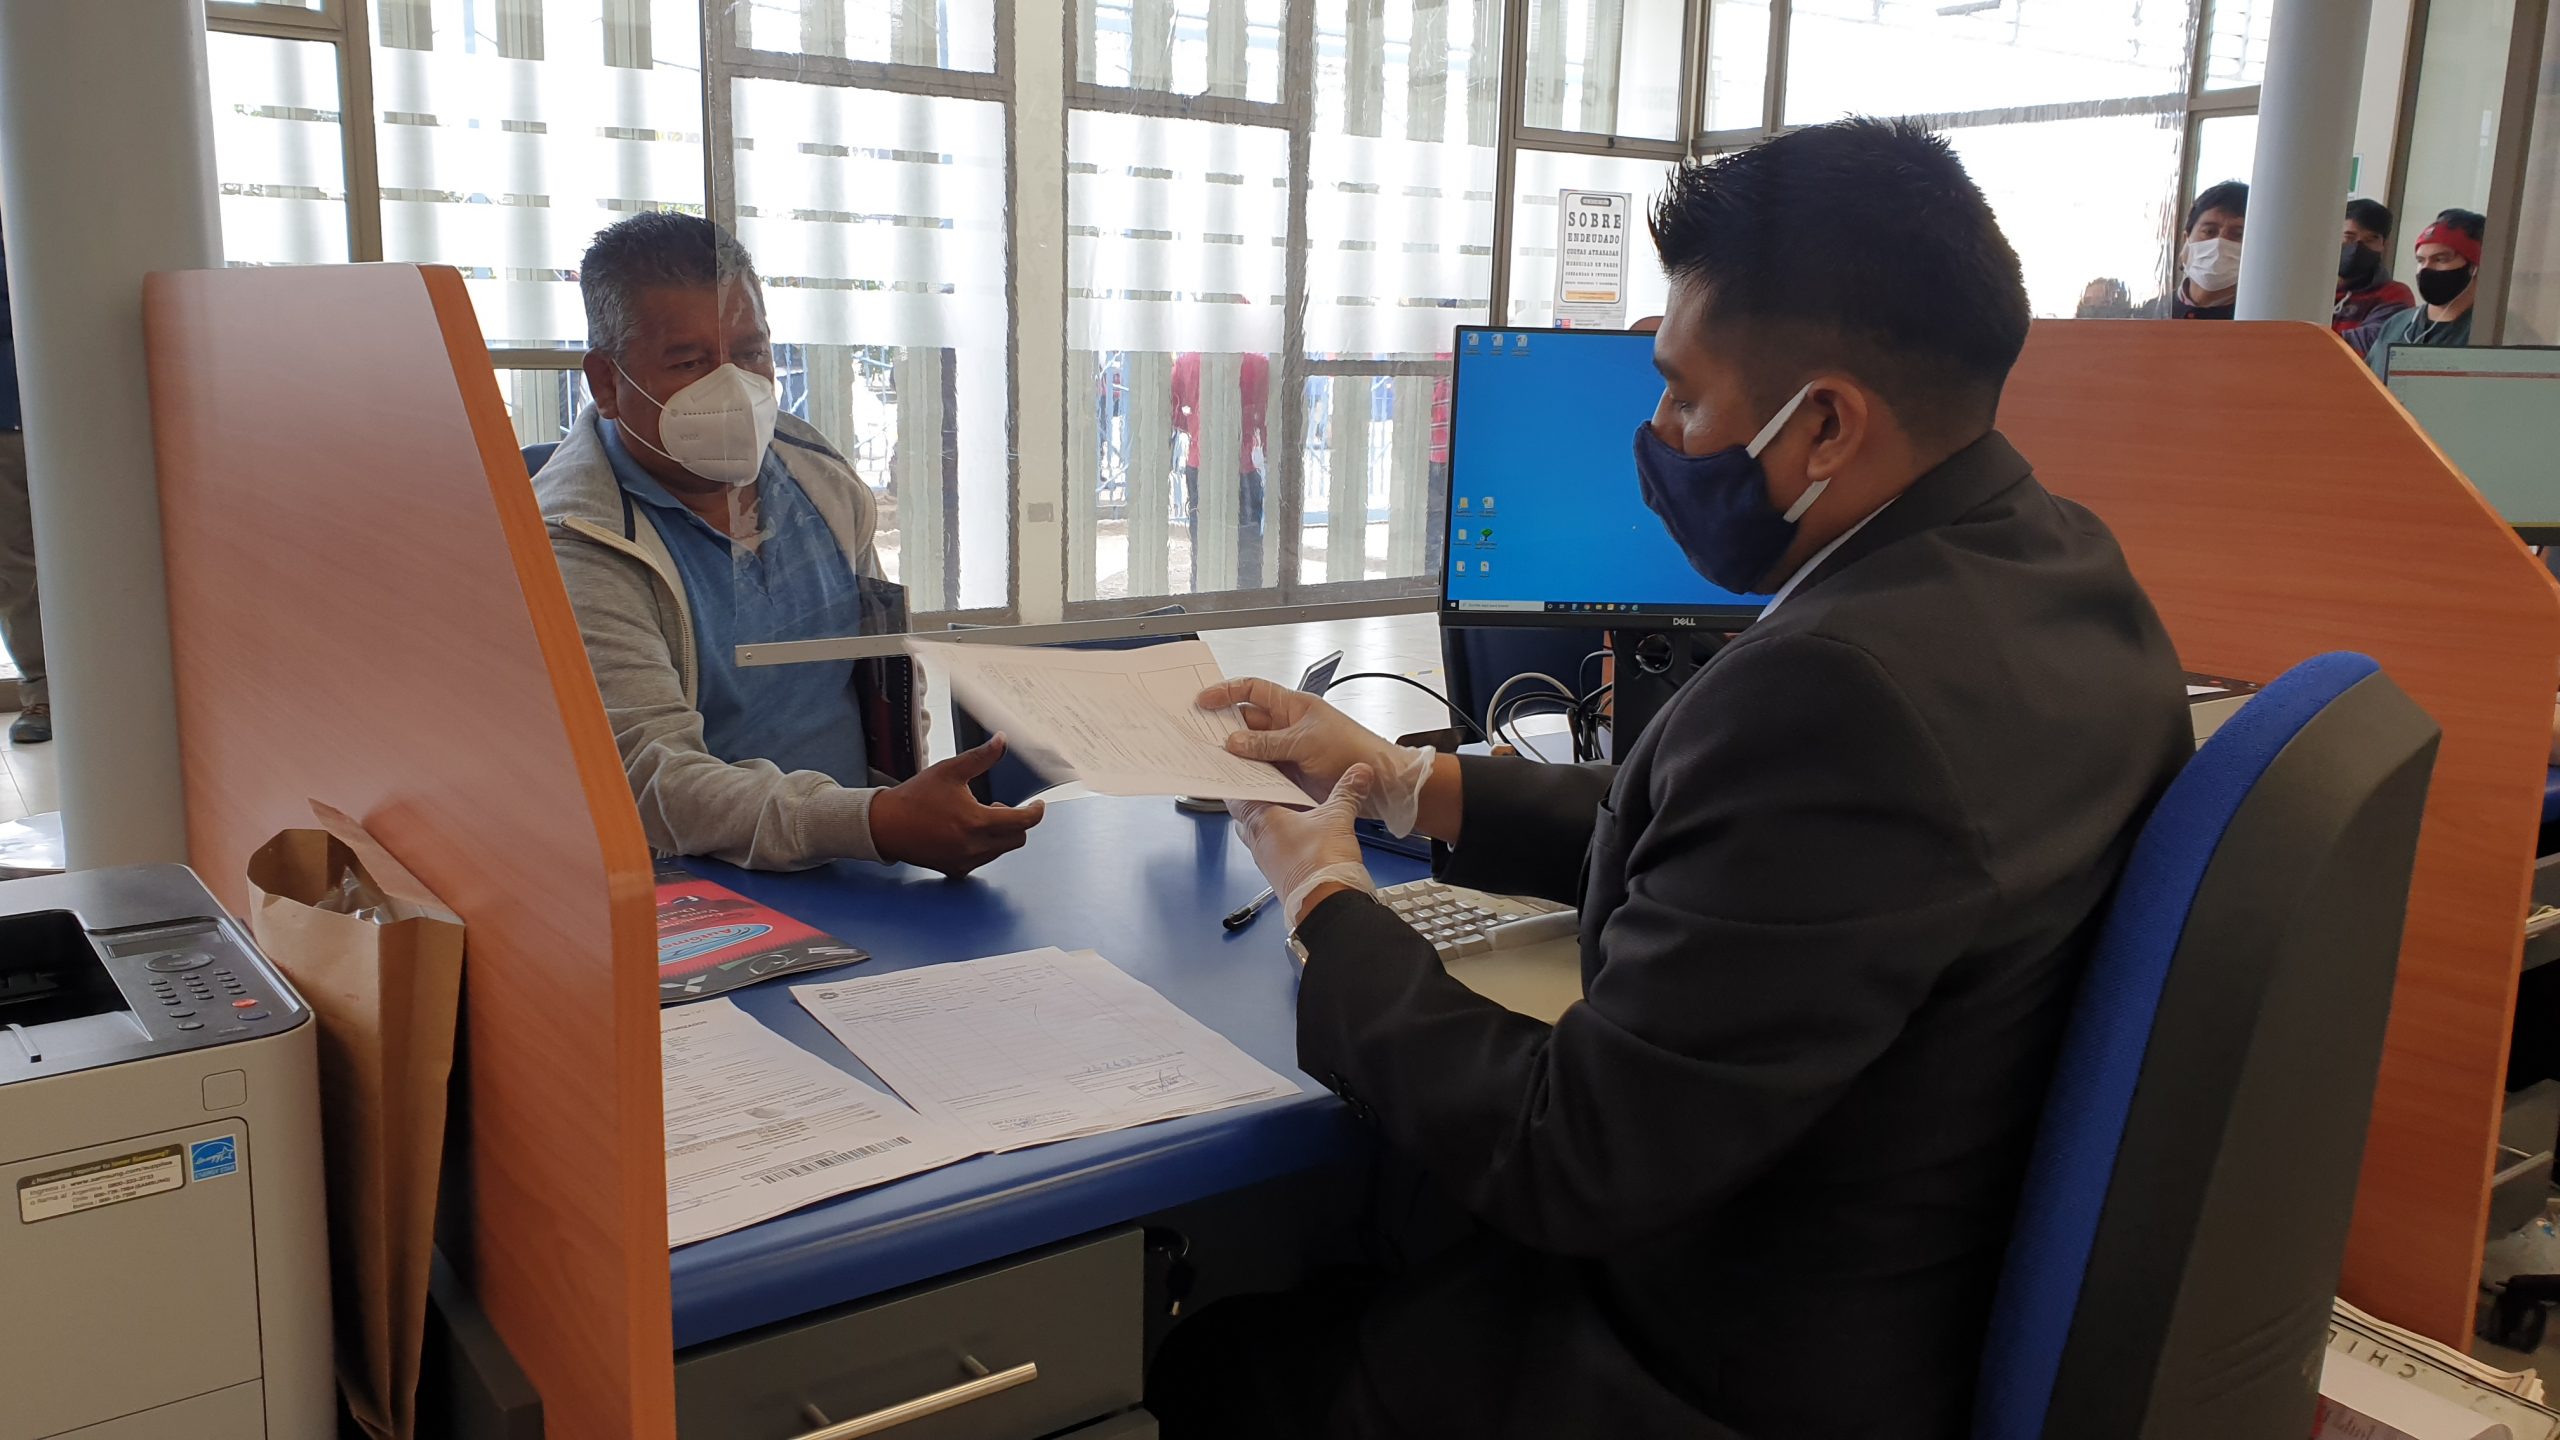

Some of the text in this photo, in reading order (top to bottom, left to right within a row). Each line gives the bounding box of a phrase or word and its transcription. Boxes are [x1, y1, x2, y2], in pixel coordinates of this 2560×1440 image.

[1568, 211, 1621, 229] SOBRE
[1567, 232, 1620, 244] ENDEUDADO
[1672, 617, 1697, 626] DELL
